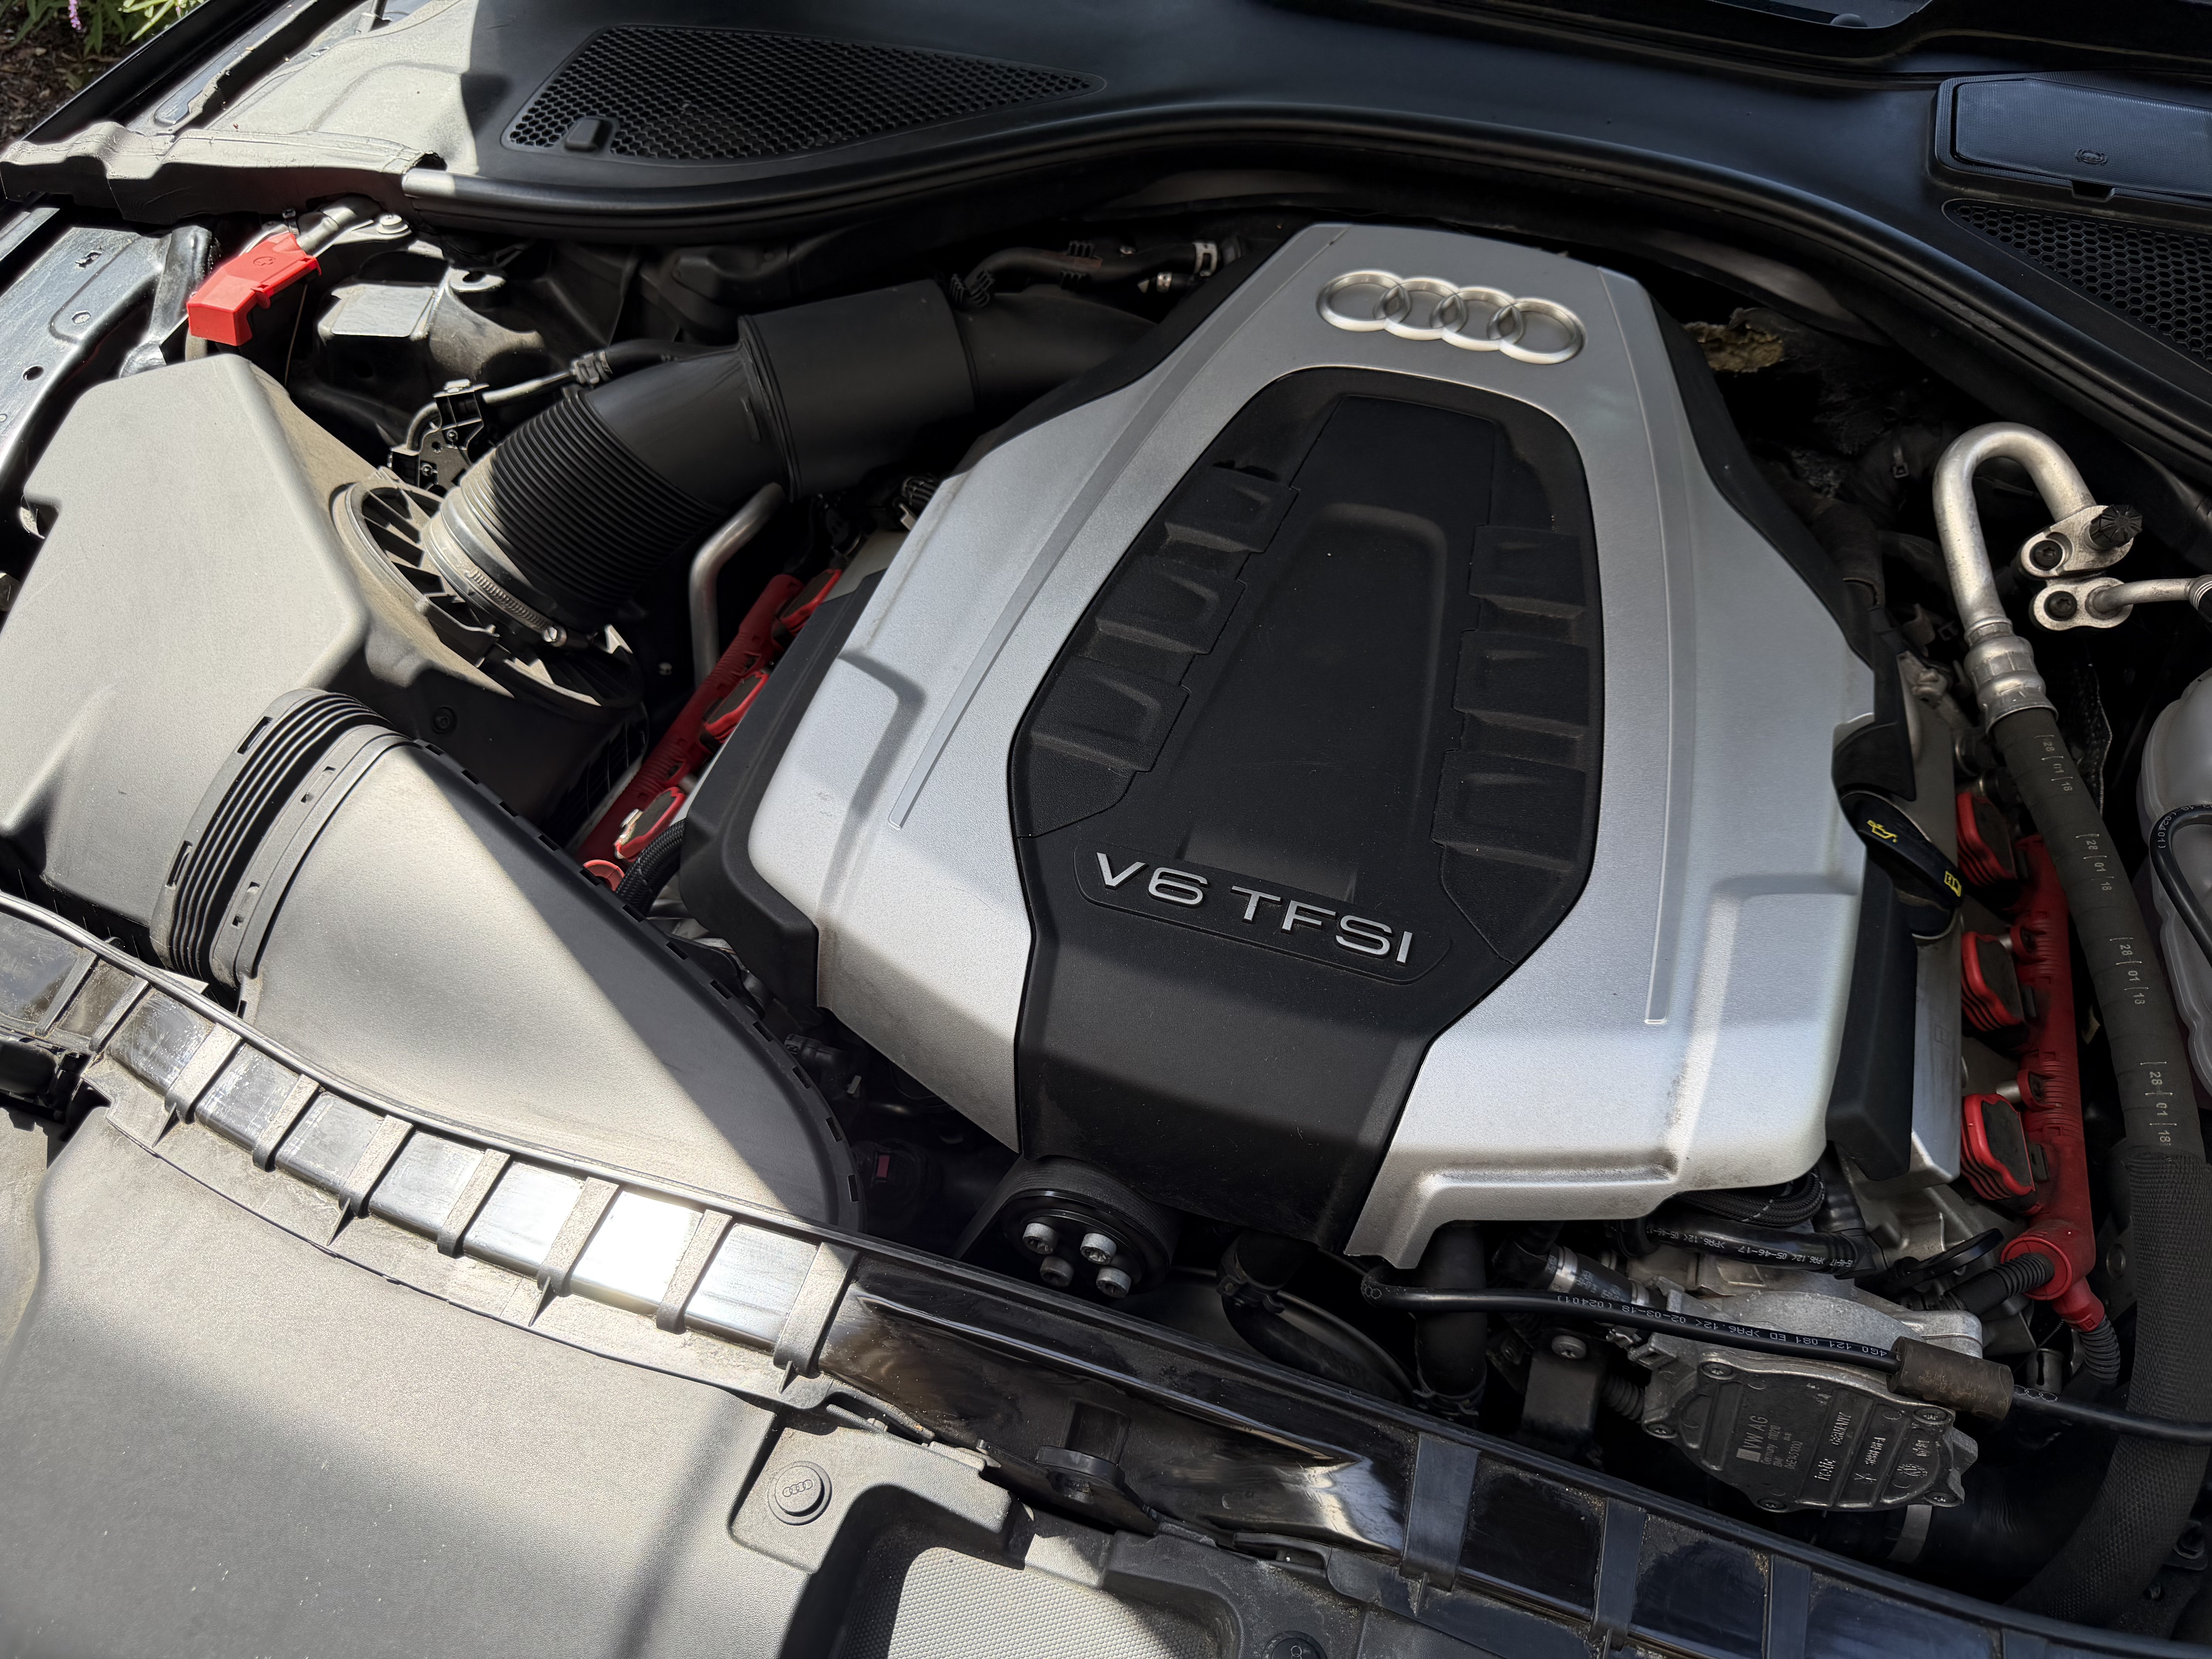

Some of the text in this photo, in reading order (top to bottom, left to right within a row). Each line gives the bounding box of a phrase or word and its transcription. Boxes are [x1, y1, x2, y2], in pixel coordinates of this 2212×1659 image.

[2042, 740, 2073, 793] 28 01 18
[2085, 838, 2112, 892] 28 01 18
[1096, 852, 1413, 966] V6 TFSI
[2119, 942, 2147, 1006] 28 01 18
[2148, 1069, 2171, 1144] 28 01 18
[1738, 1245, 1787, 1261] 05-46-17
[1771, 1331, 1786, 1342] ED
[1828, 1340, 1852, 1351] 121
[1743, 1415, 1768, 1451] VW AG
[1830, 1412, 1851, 1446] GERMANY
[1760, 1443, 1778, 1465] Germany
